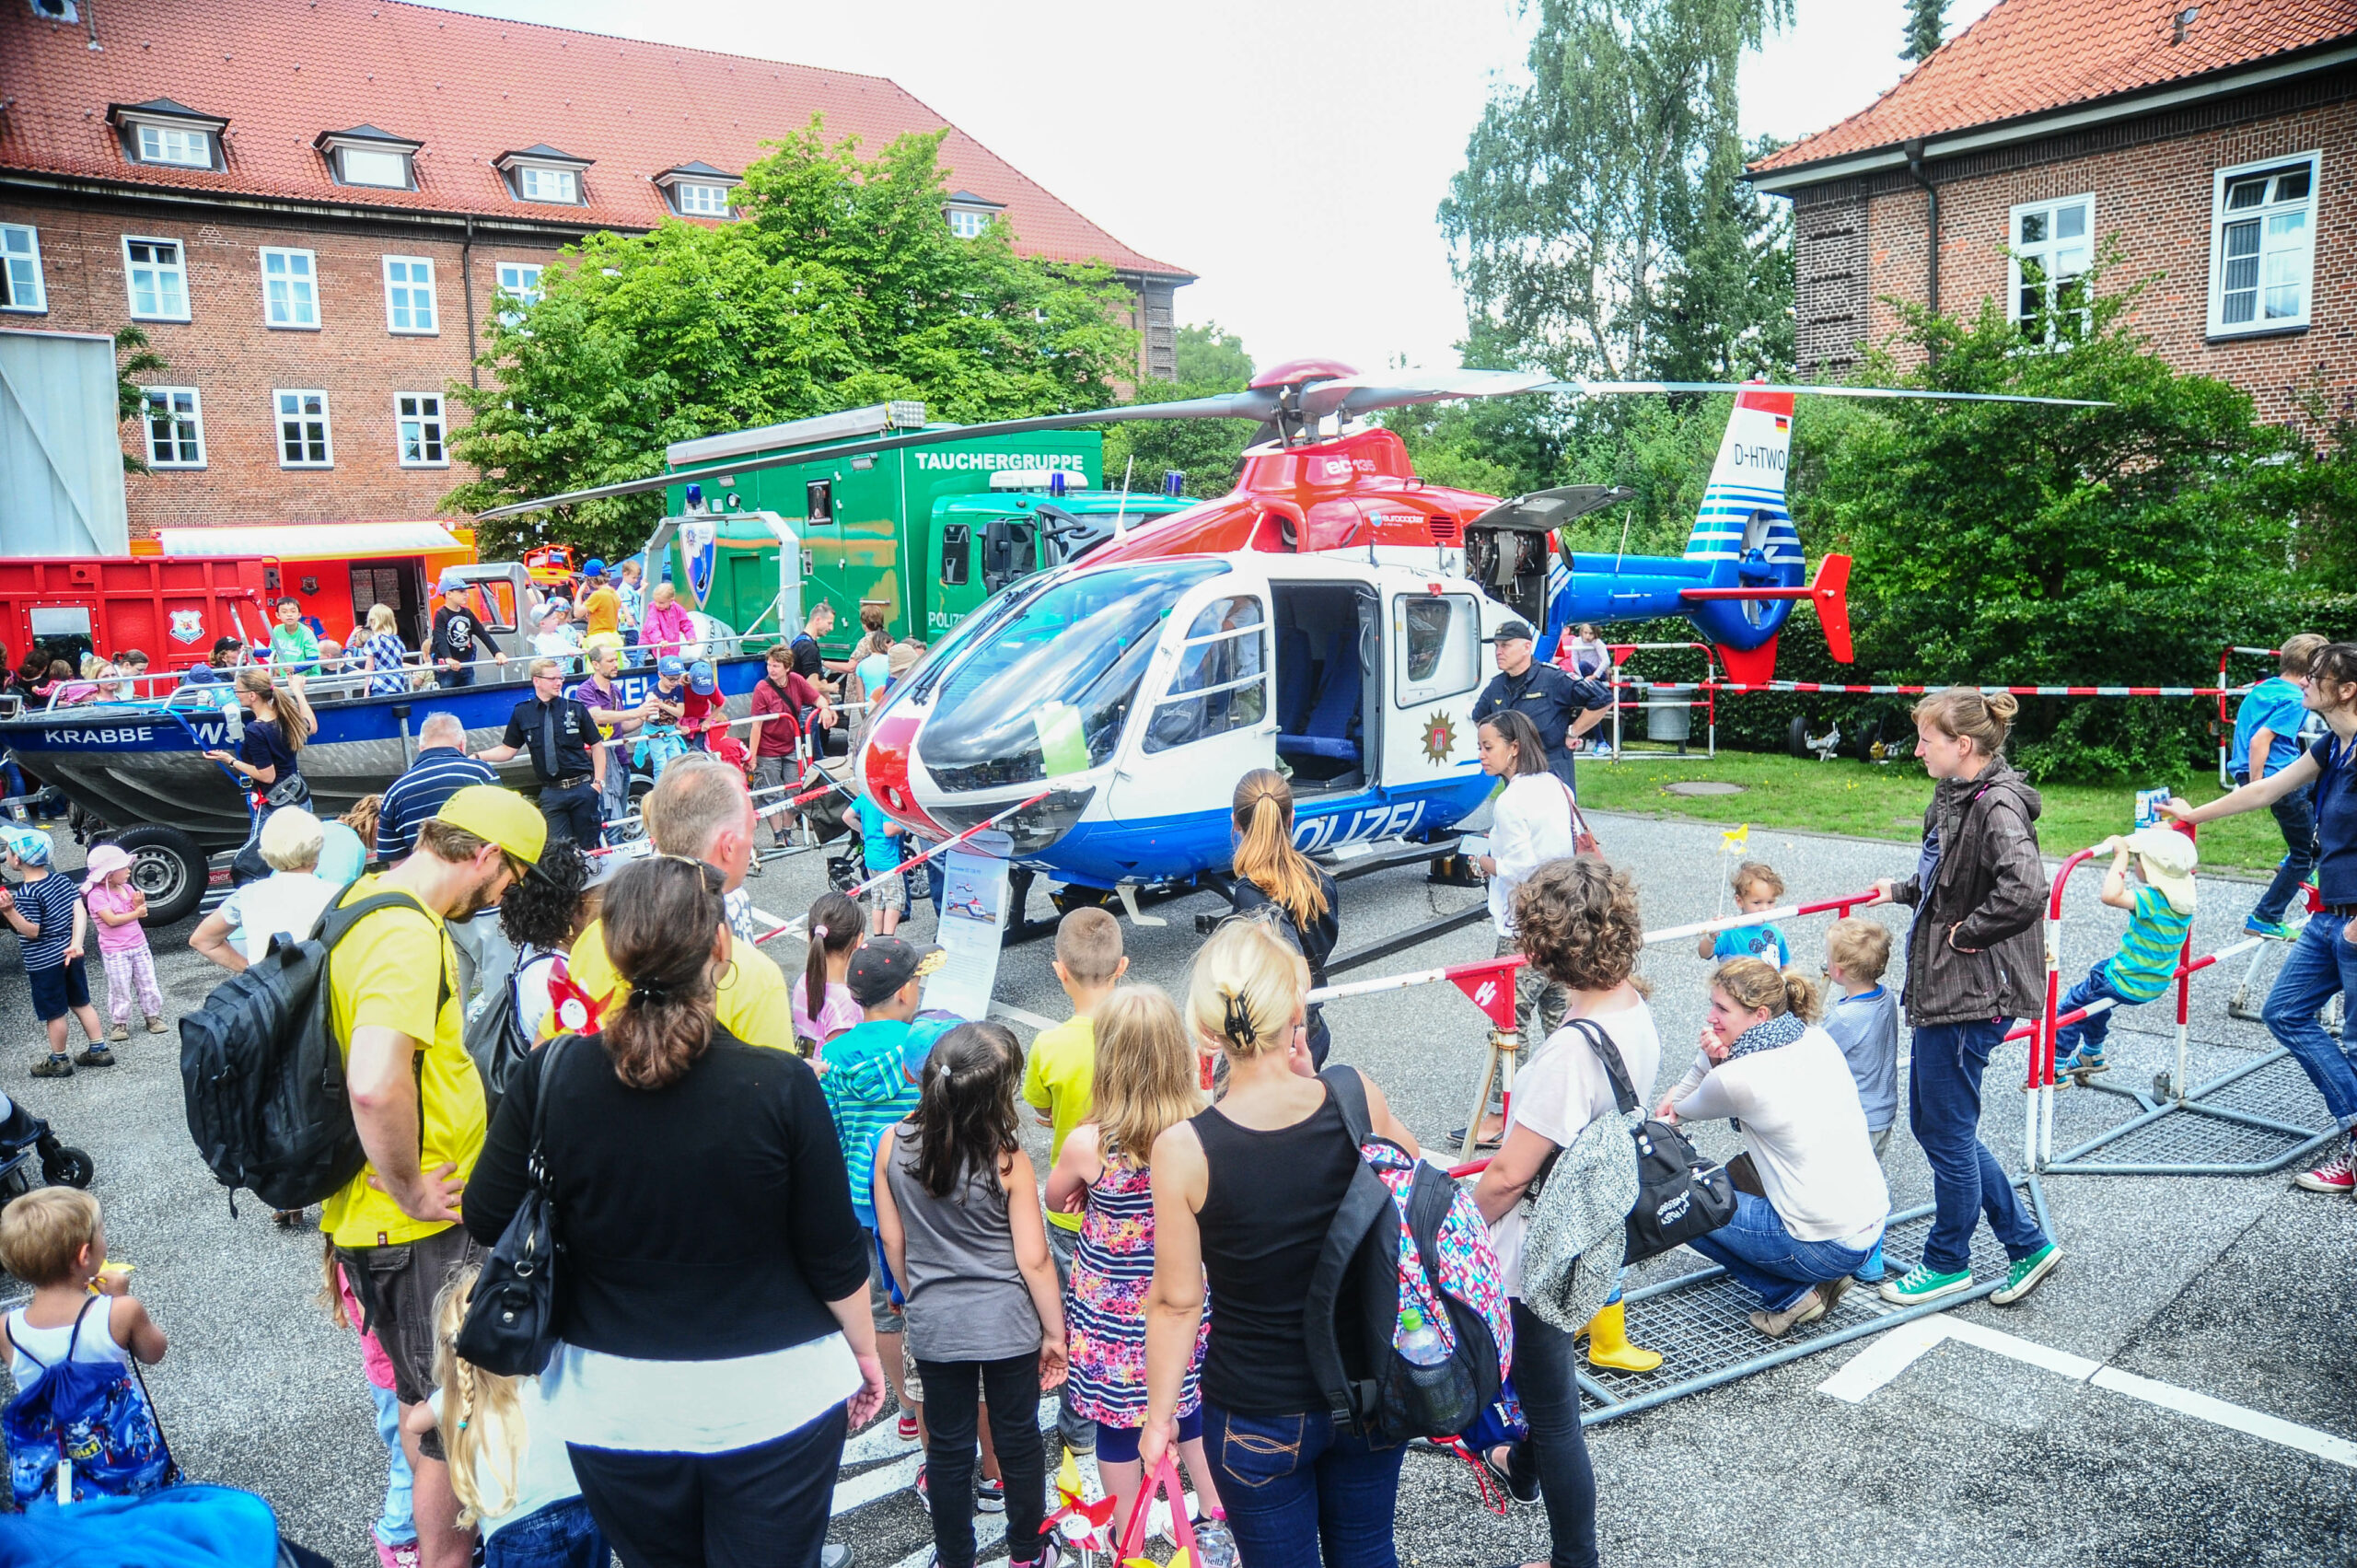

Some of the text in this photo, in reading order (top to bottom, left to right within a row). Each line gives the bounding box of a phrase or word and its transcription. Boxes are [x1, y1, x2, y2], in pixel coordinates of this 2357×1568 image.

[914, 452, 1084, 470] TAUCHERGRUPPE
[1734, 443, 1785, 470] D-HTWO
[44, 726, 154, 744] KRABBE
[1292, 800, 1426, 854] OLIZEI
[1204, 1556, 1224, 1567] hella
